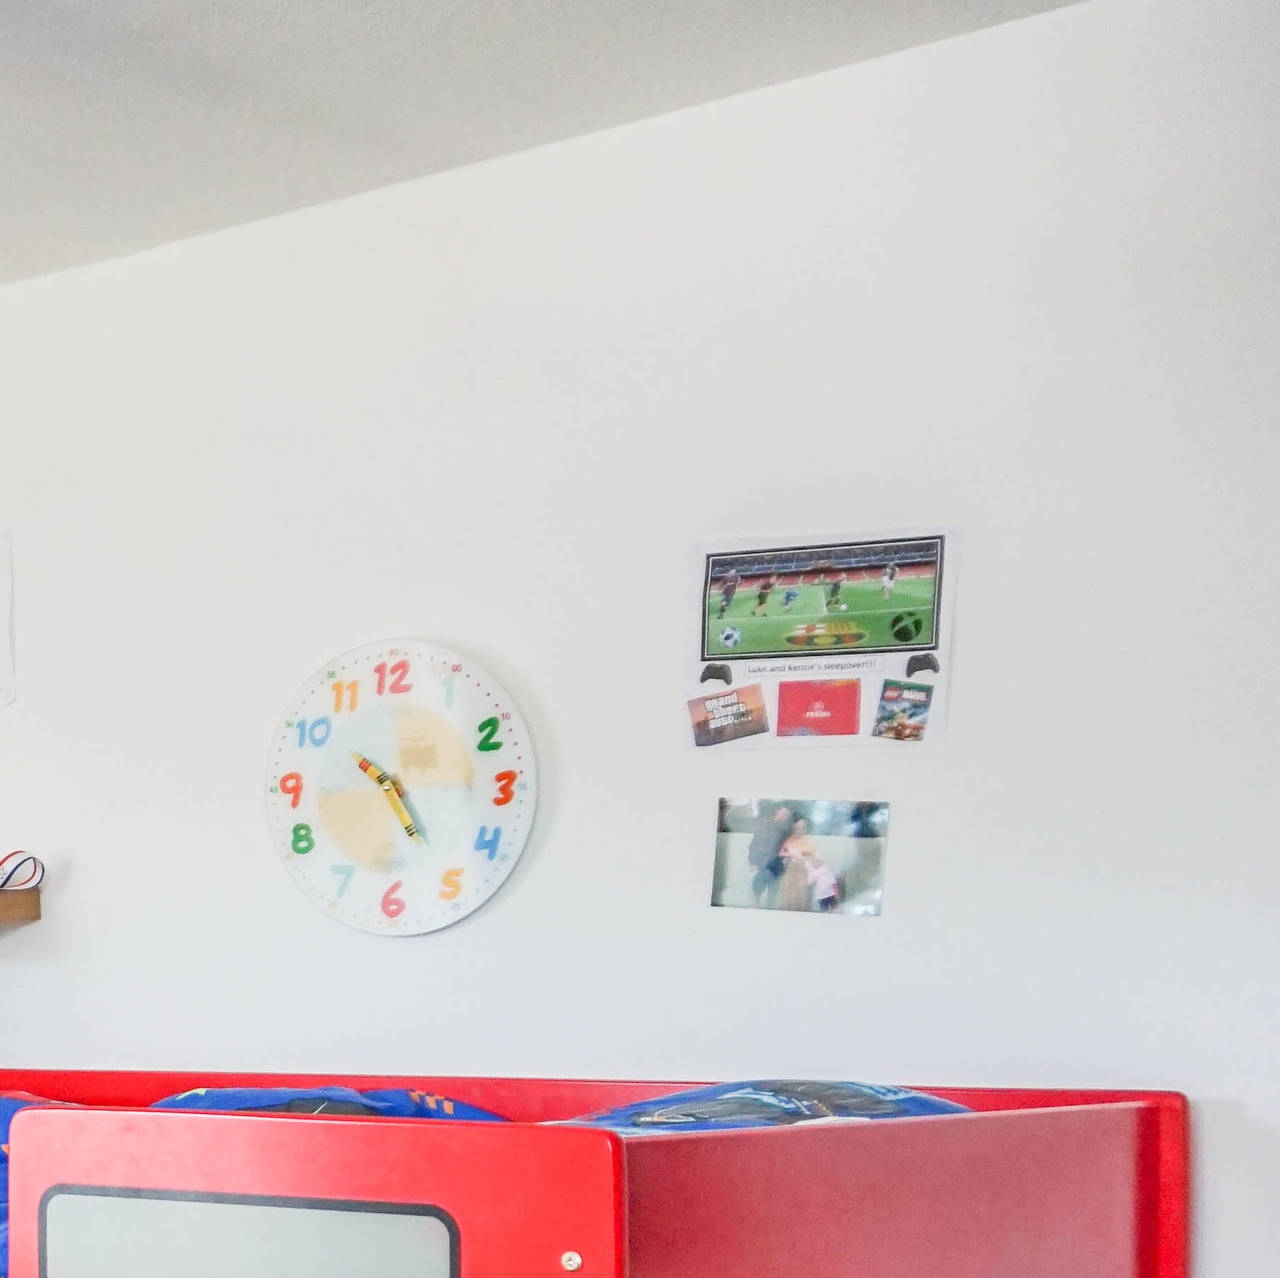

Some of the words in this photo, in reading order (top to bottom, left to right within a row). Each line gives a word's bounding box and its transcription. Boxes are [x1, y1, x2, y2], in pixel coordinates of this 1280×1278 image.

[374, 659, 414, 696] 12
[442, 675, 455, 709] 1
[331, 680, 359, 713] 11
[296, 716, 332, 748] 10
[501, 712, 511, 721] 10
[477, 716, 503, 752] 2
[280, 772, 303, 809] 9
[493, 770, 517, 806] 3
[291, 823, 315, 855] 8
[474, 825, 501, 860] 4
[330, 865, 355, 898] 7
[439, 868, 464, 900] 5
[381, 880, 406, 918] 6
